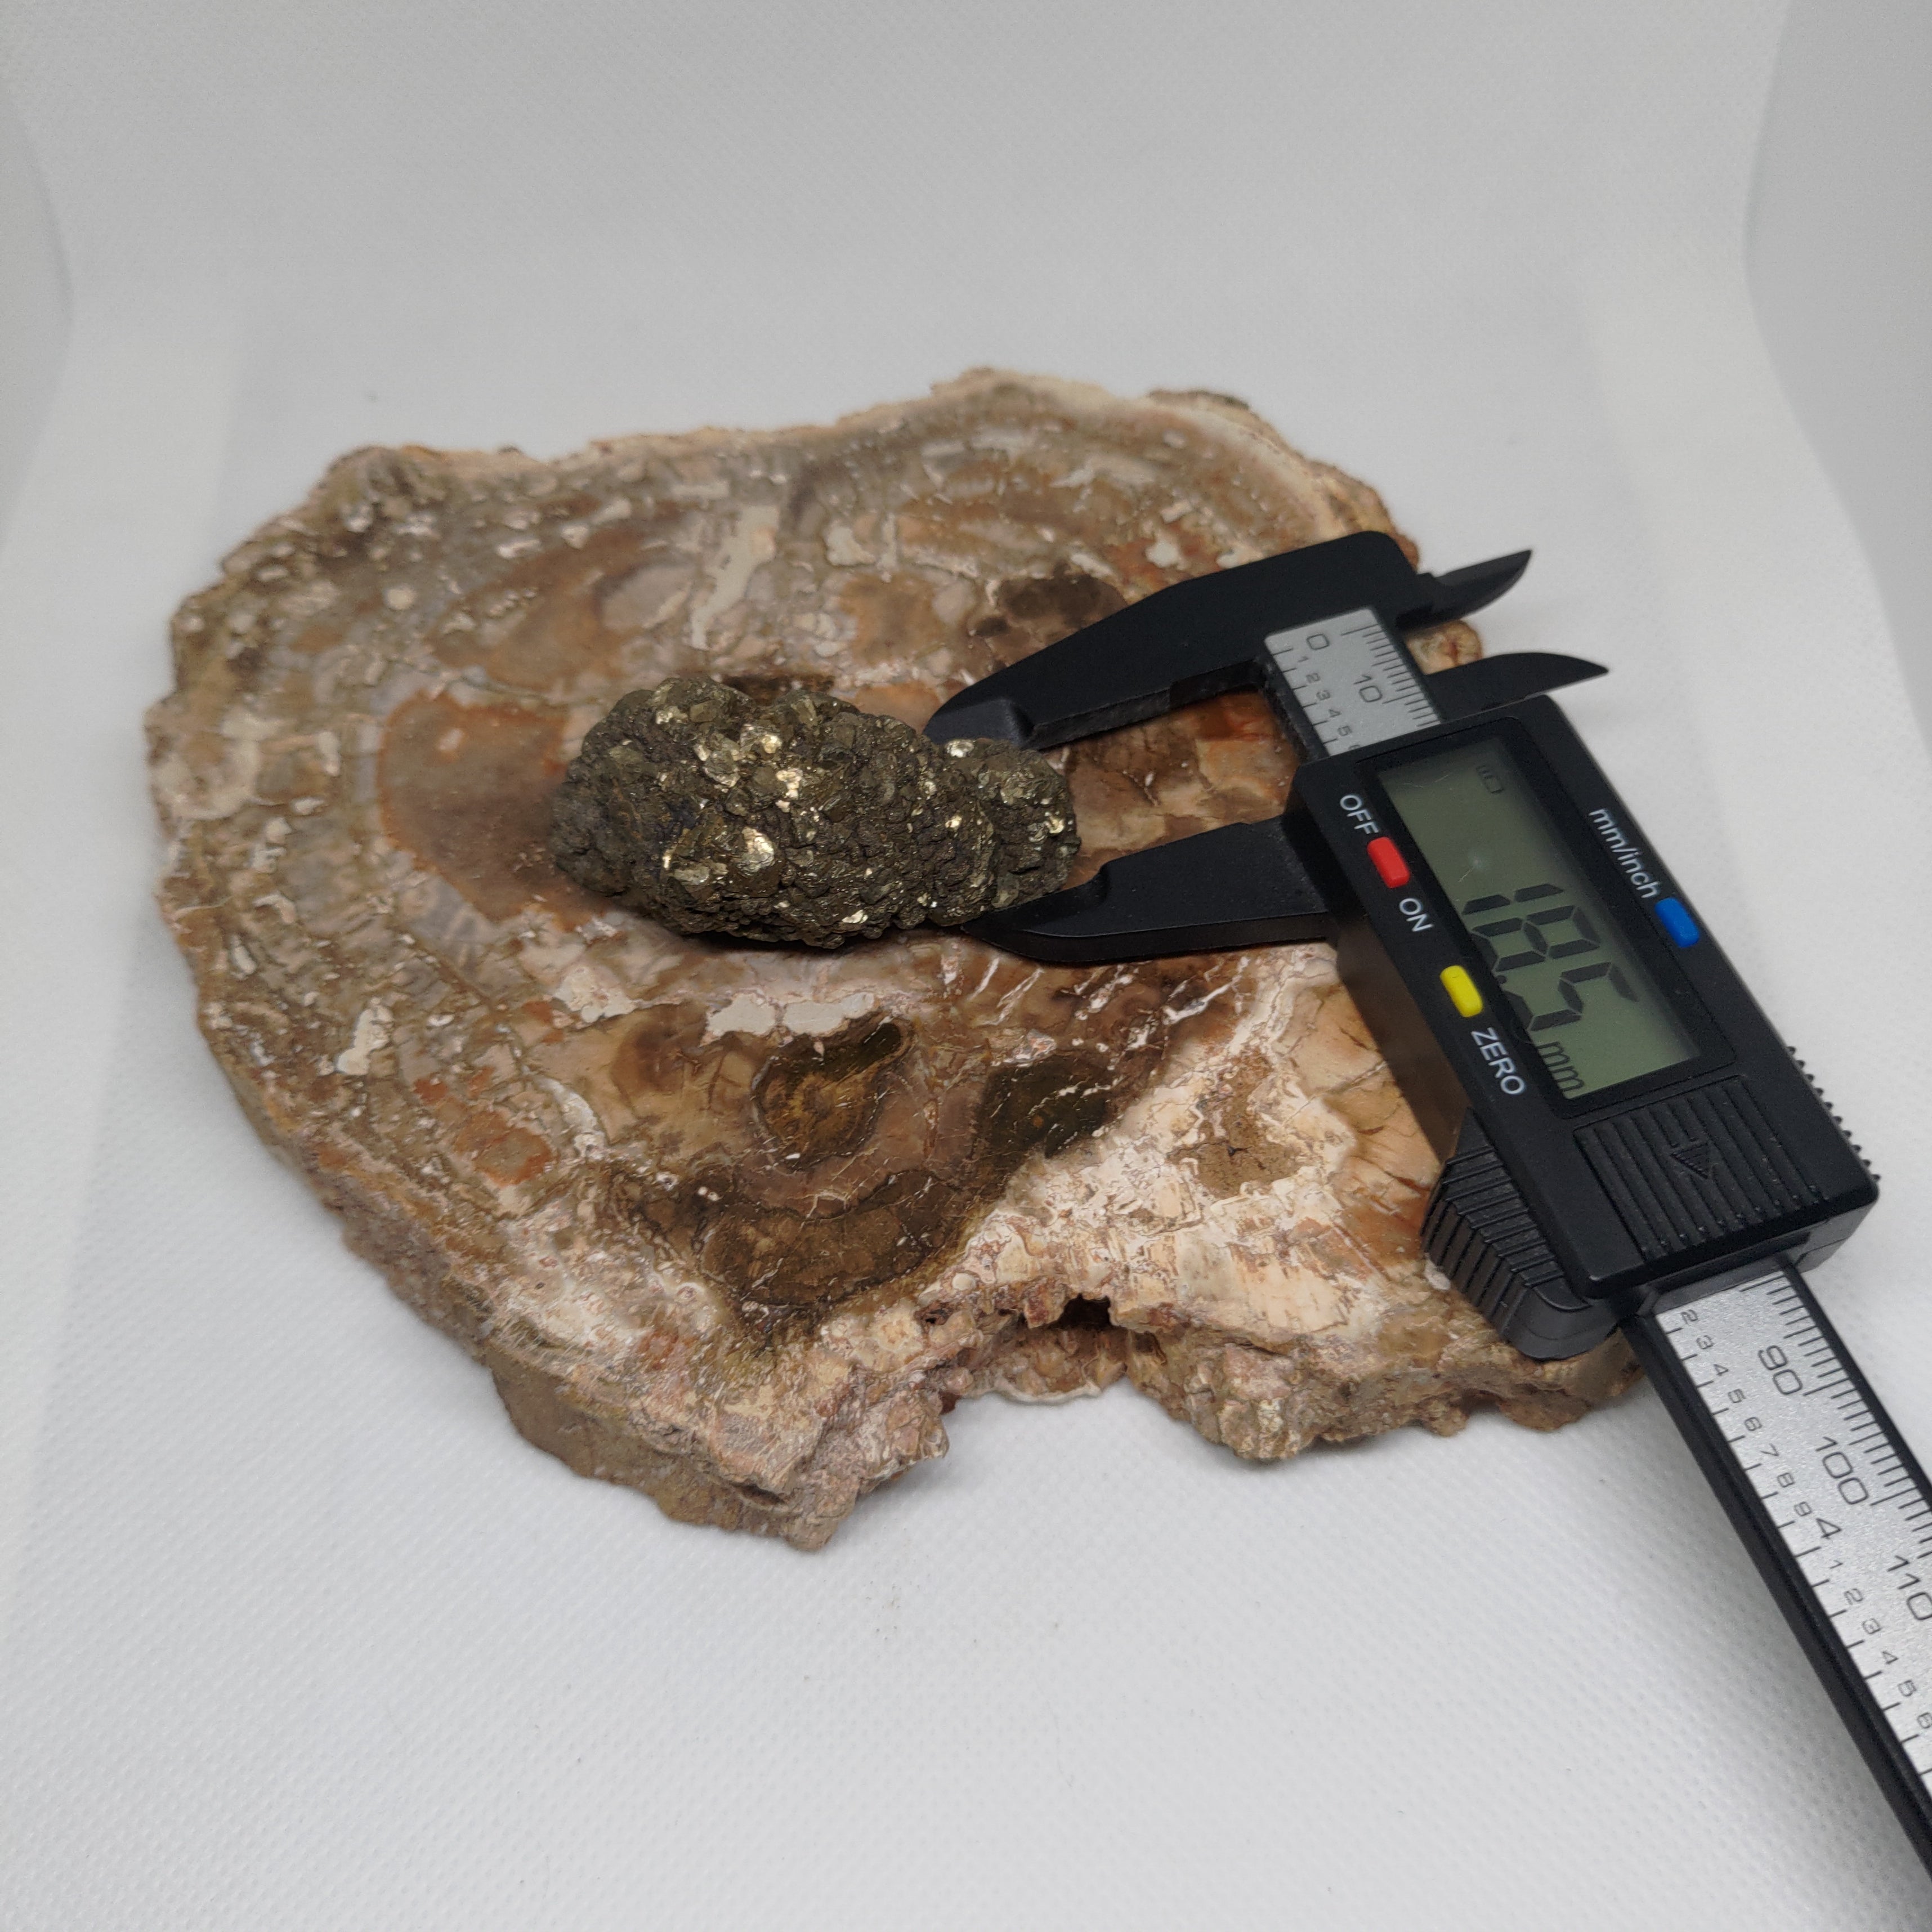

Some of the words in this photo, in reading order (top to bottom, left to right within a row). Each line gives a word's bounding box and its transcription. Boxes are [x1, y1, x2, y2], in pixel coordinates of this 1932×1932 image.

[1307, 633, 1330, 650] 0
[1306, 672, 1321, 683] 2
[1316, 690, 1331, 701] 3
[1353, 674, 1383, 703] 10
[1329, 709, 1342, 718] 4
[1337, 725, 1352, 737] 5
[1340, 794, 1379, 834] OFF
[1588, 808, 1659, 898] mm/inch
[1399, 898, 1434, 932] ON
[1470, 1027, 1526, 1094] ZERO
[1536, 1041, 1585, 1092] mm
[1681, 1309, 1698, 1323] 2
[1696, 1335, 1714, 1350] 3
[1713, 1363, 1730, 1377] 4
[1757, 1345, 1803, 1395] 90
[1728, 1388, 1746, 1403] 5
[1744, 1416, 1763, 1432] 6
[1760, 1443, 1779, 1456] 7
[1815, 1436, 1868, 1505] 100
[1777, 1472, 1796, 1488] 8
[1794, 1501, 1812, 1517] 9
[1815, 1518, 1842, 1540] 4
[1830, 1559, 1844, 1569] 1
[1887, 1554, 1932, 1621] 110
[1844, 1588, 1864, 1605] 2
[1862, 1617, 1882, 1635] 3
[1881, 1651, 1899, 1665] 4
[1898, 1679, 1917, 1697] 5
